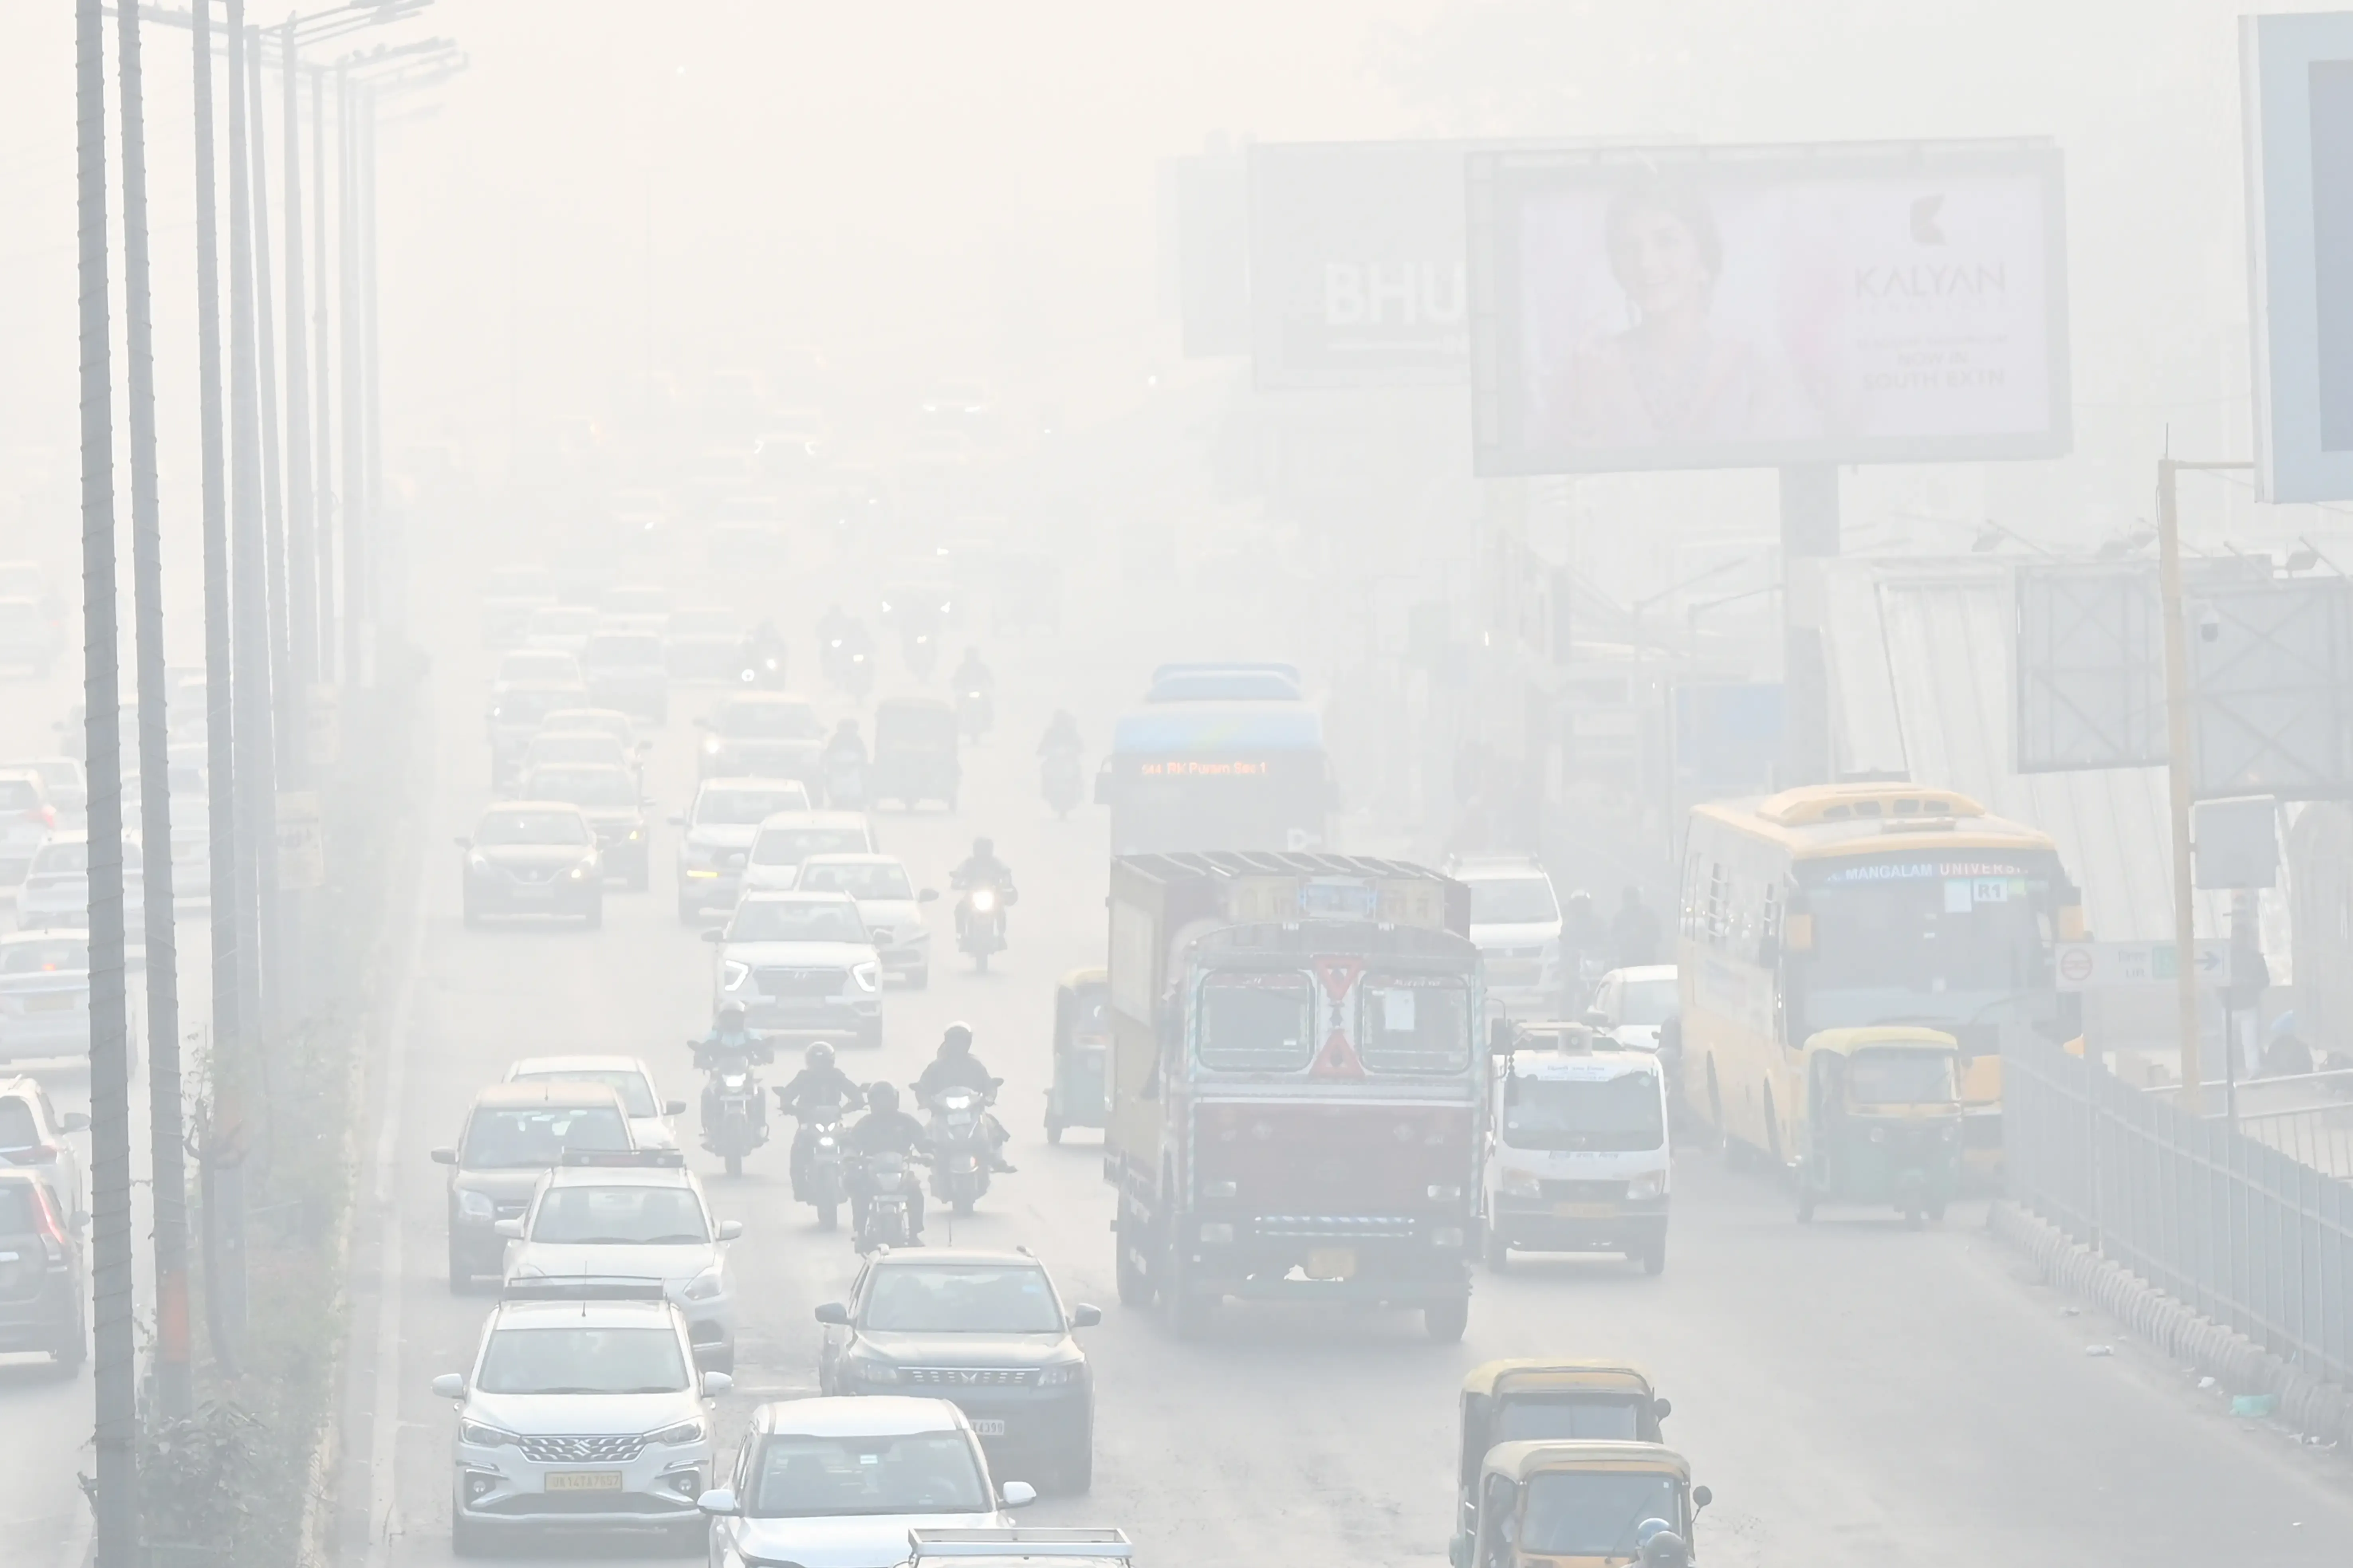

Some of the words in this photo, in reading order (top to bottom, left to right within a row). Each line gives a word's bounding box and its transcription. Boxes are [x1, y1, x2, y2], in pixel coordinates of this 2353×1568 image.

[1855, 262, 2006, 299] KALYAN
[1325, 261, 1467, 325] BHU
[1949, 351, 1969, 365] IN
[1863, 371, 1939, 391] SOUTH
[1845, 864, 1932, 880] MANGALAM
[1978, 884, 2001, 899] R1
